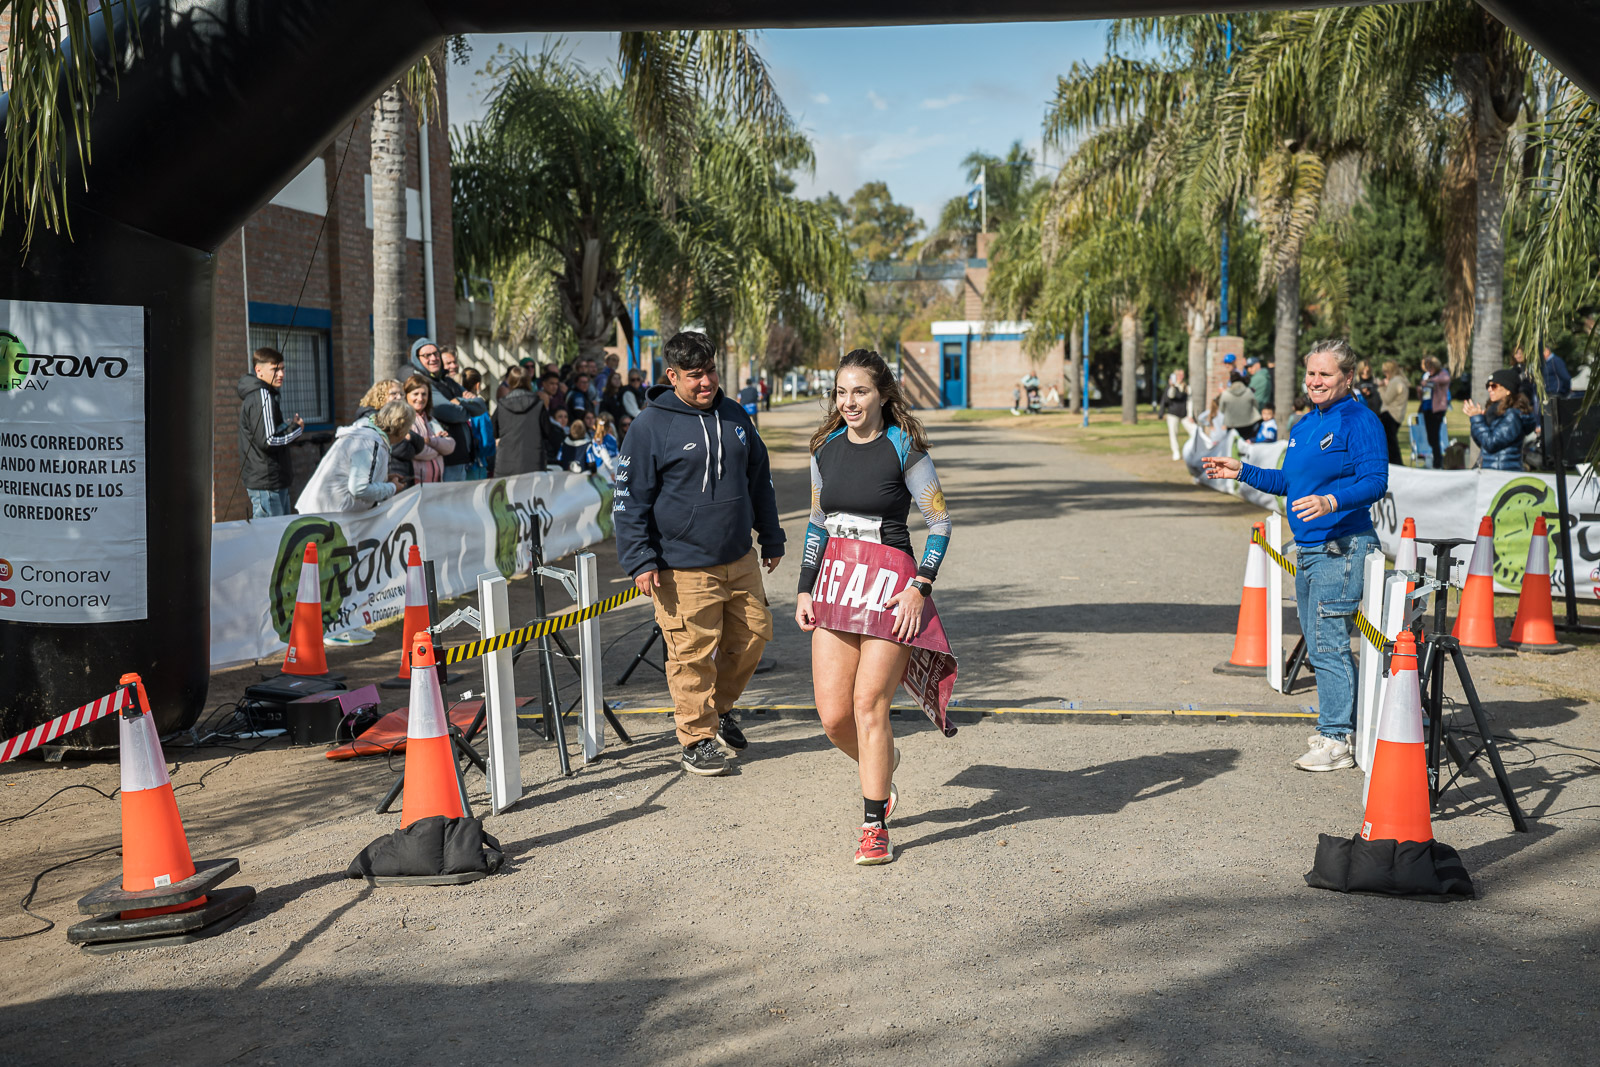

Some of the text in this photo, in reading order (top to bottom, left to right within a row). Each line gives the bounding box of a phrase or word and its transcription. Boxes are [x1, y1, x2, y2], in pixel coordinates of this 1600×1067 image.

[13, 353, 128, 378] CRONO
[11, 379, 48, 390] RAV
[0, 432, 123, 451] MOS CORREDORES
[39, 459, 107, 474] MEJORAR
[111, 460, 136, 473] LAS
[75, 484, 93, 497] DE
[98, 483, 123, 497] LOS
[21, 565, 110, 583] Cronorav
[21, 590, 110, 607] Cronorav
